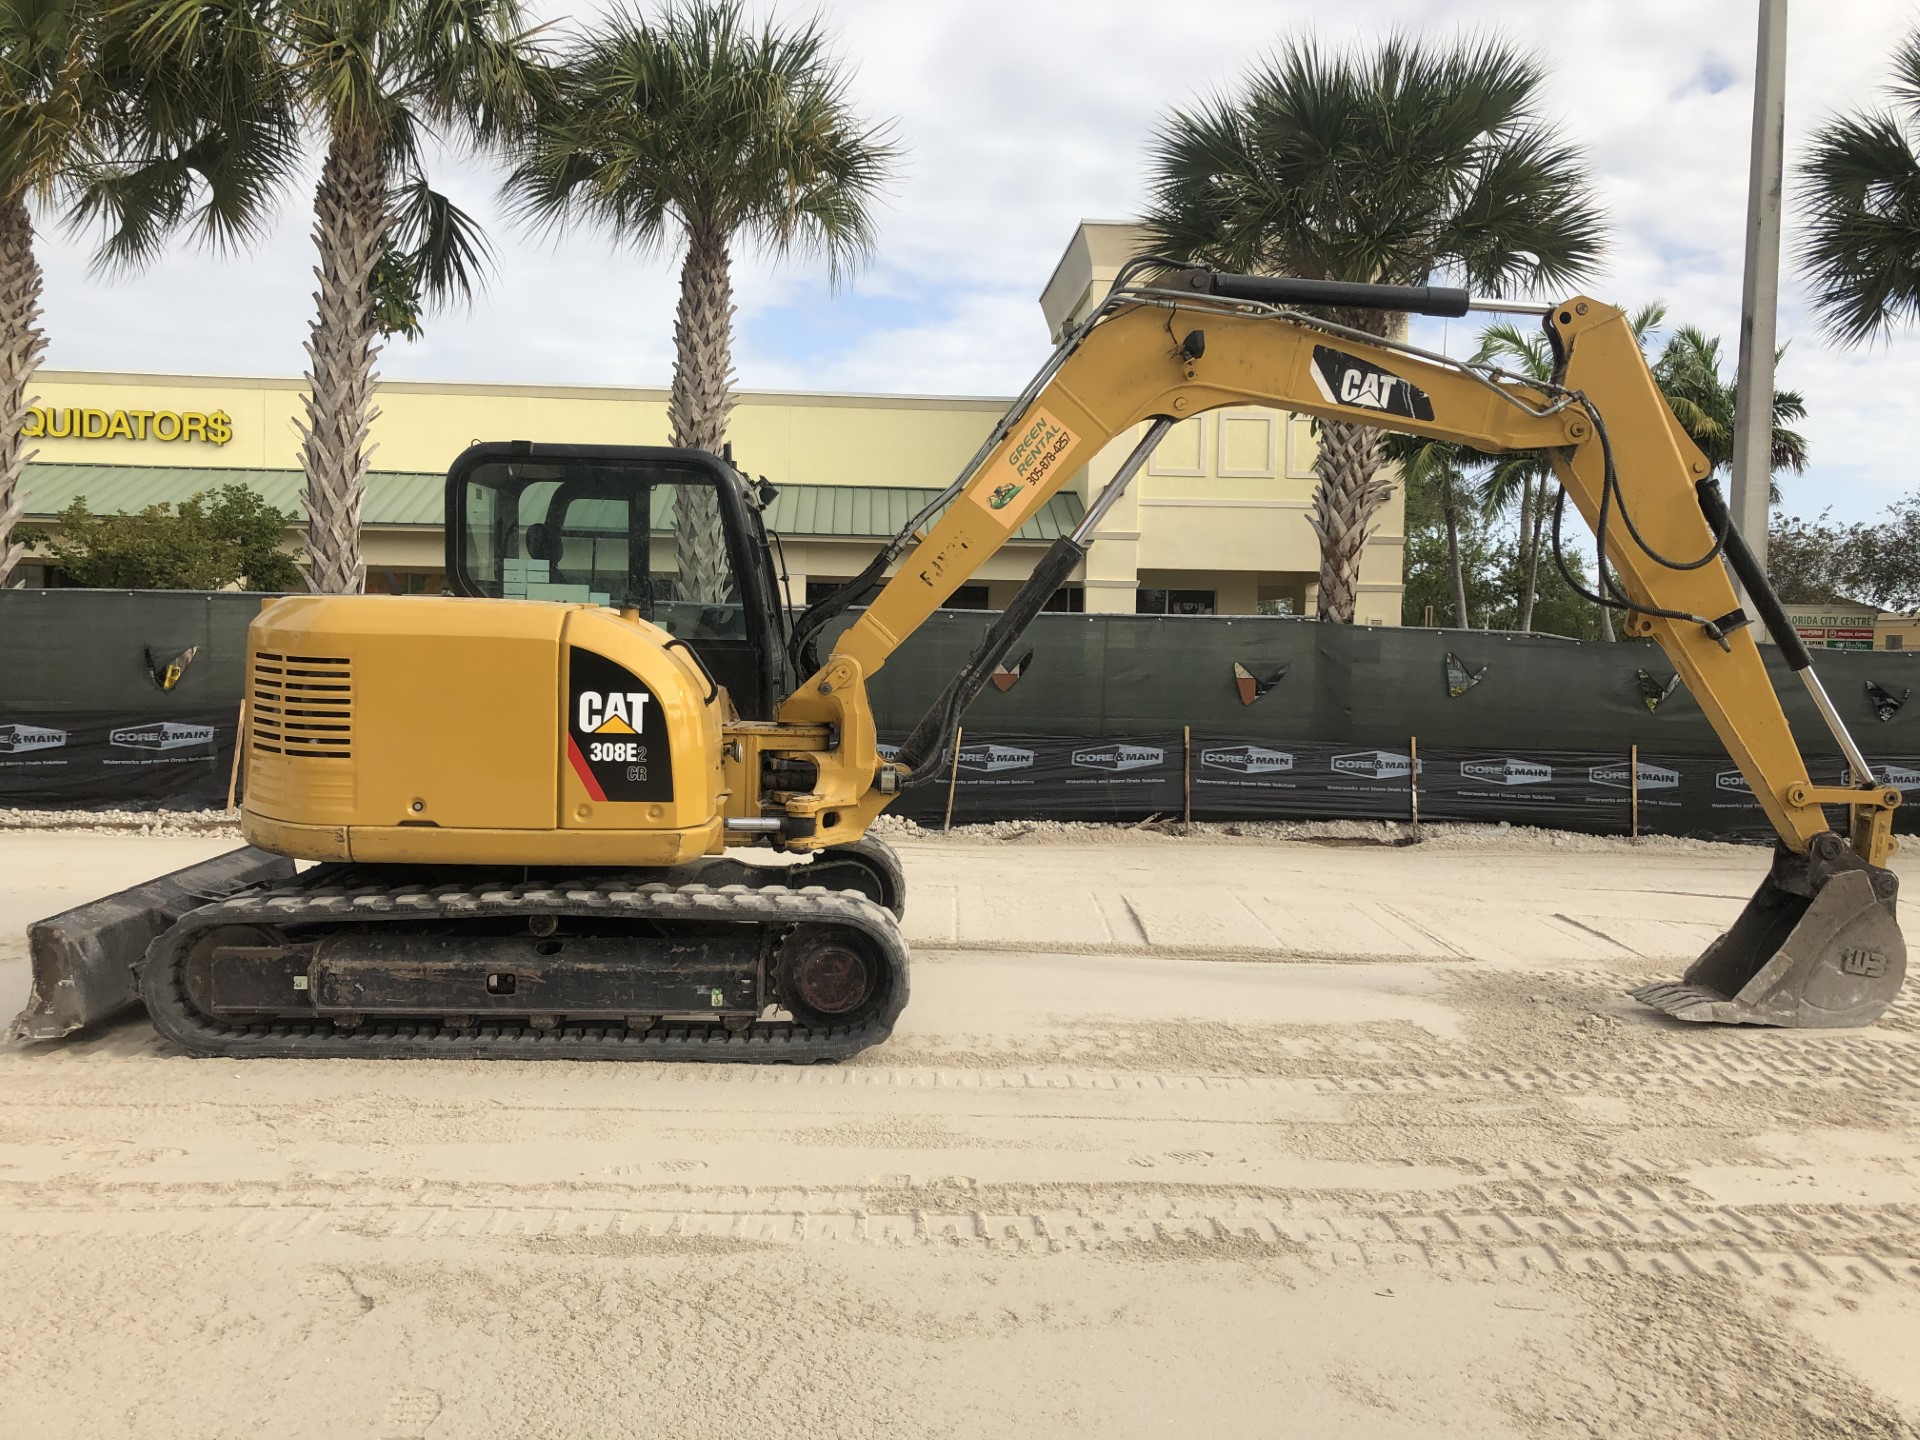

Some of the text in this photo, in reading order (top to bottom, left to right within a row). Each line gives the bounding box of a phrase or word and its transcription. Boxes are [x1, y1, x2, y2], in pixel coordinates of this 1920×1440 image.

[1341, 368, 1397, 409] CAT
[1009, 417, 1047, 466] GREEN
[1017, 425, 1061, 477] RENTAL
[1026, 431, 1070, 486] 305-878-4257
[1820, 616, 1839, 625] CITY
[579, 691, 649, 734] CAT
[590, 742, 647, 762] 308E2
[957, 752, 1030, 763] ORE&MAIN
[626, 765, 648, 781] CR
[1593, 770, 1675, 783] COREMAIN
